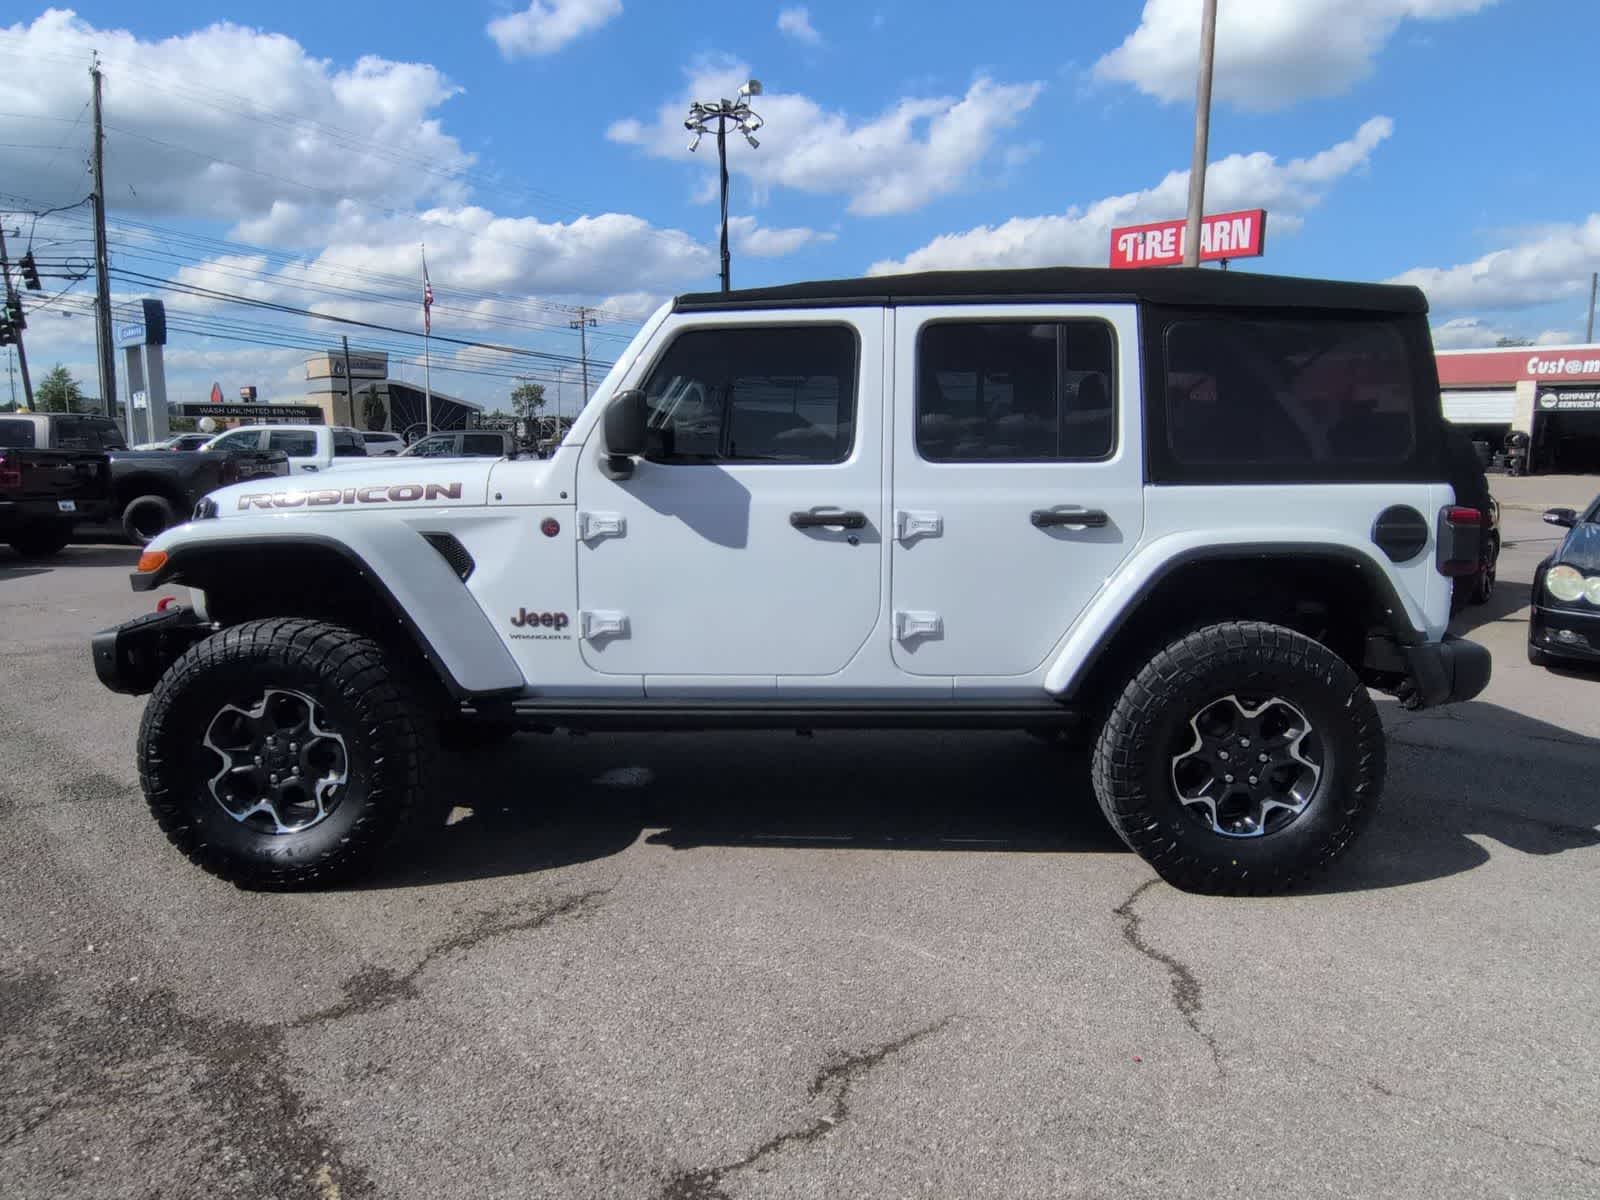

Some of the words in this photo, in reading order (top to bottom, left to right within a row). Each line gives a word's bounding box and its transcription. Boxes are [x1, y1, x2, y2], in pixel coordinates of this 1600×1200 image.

[199, 407, 225, 415] WASH
[226, 407, 270, 416] UNLIMITED
[238, 482, 463, 511] RUBICON
[510, 607, 569, 631] Jeep
